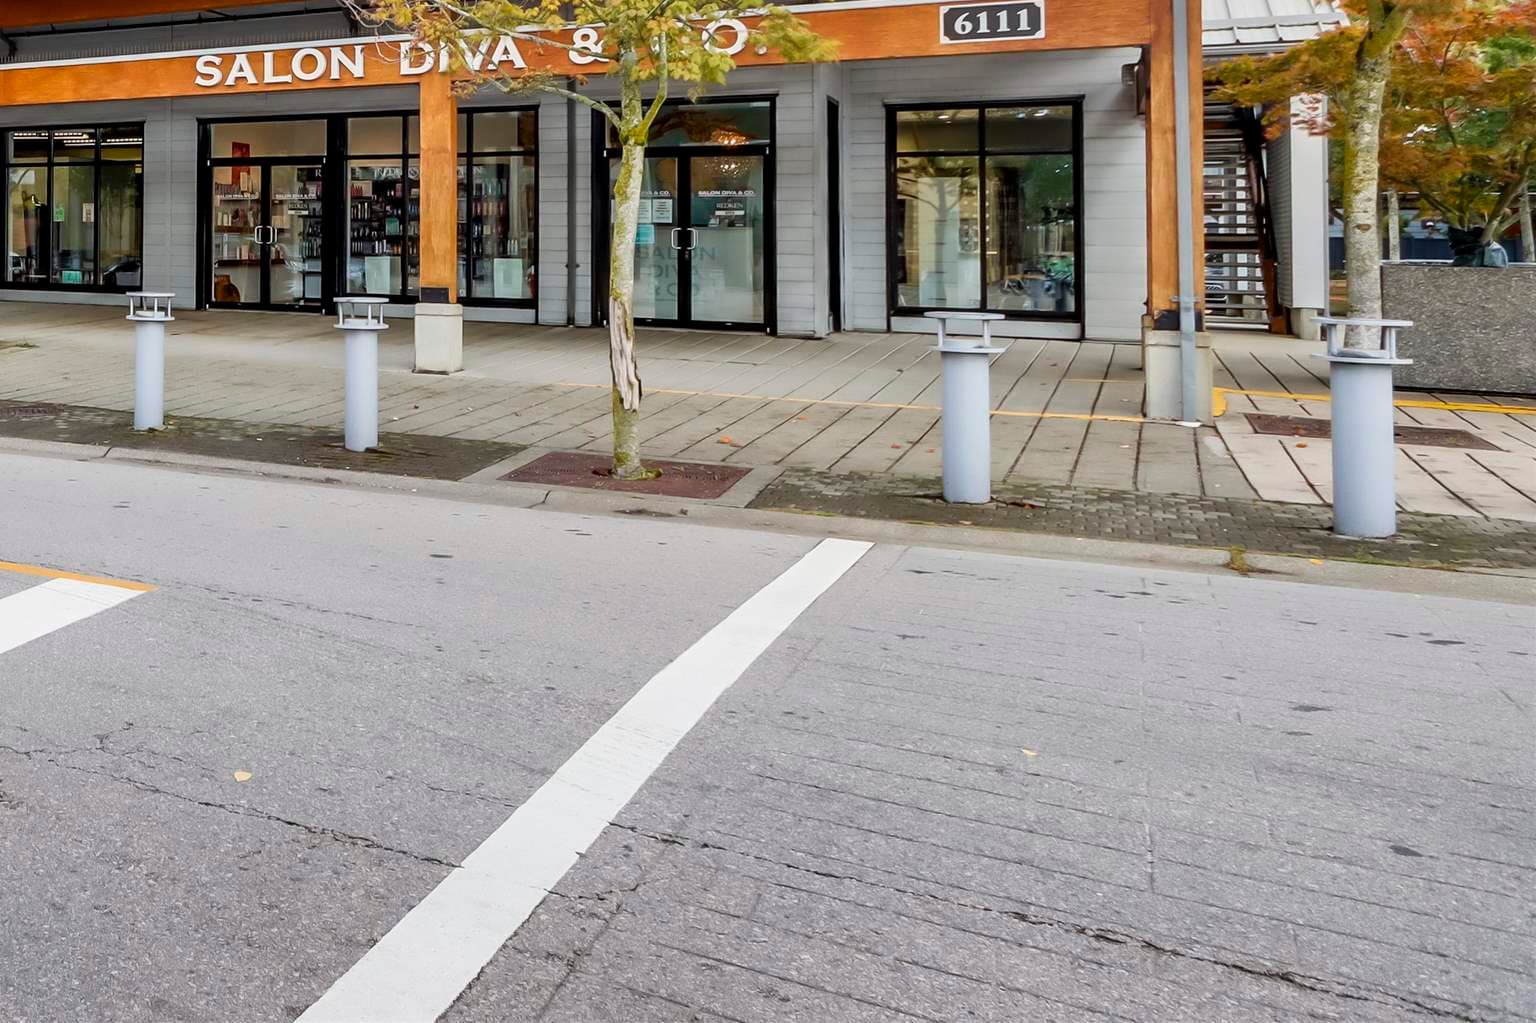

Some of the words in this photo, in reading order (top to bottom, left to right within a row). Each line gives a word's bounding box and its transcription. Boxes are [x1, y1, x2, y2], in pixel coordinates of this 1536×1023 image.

[954, 9, 1031, 35] 6111
[194, 45, 365, 87] SALON
[399, 35, 528, 76] DIVA
[568, 28, 610, 65] &
